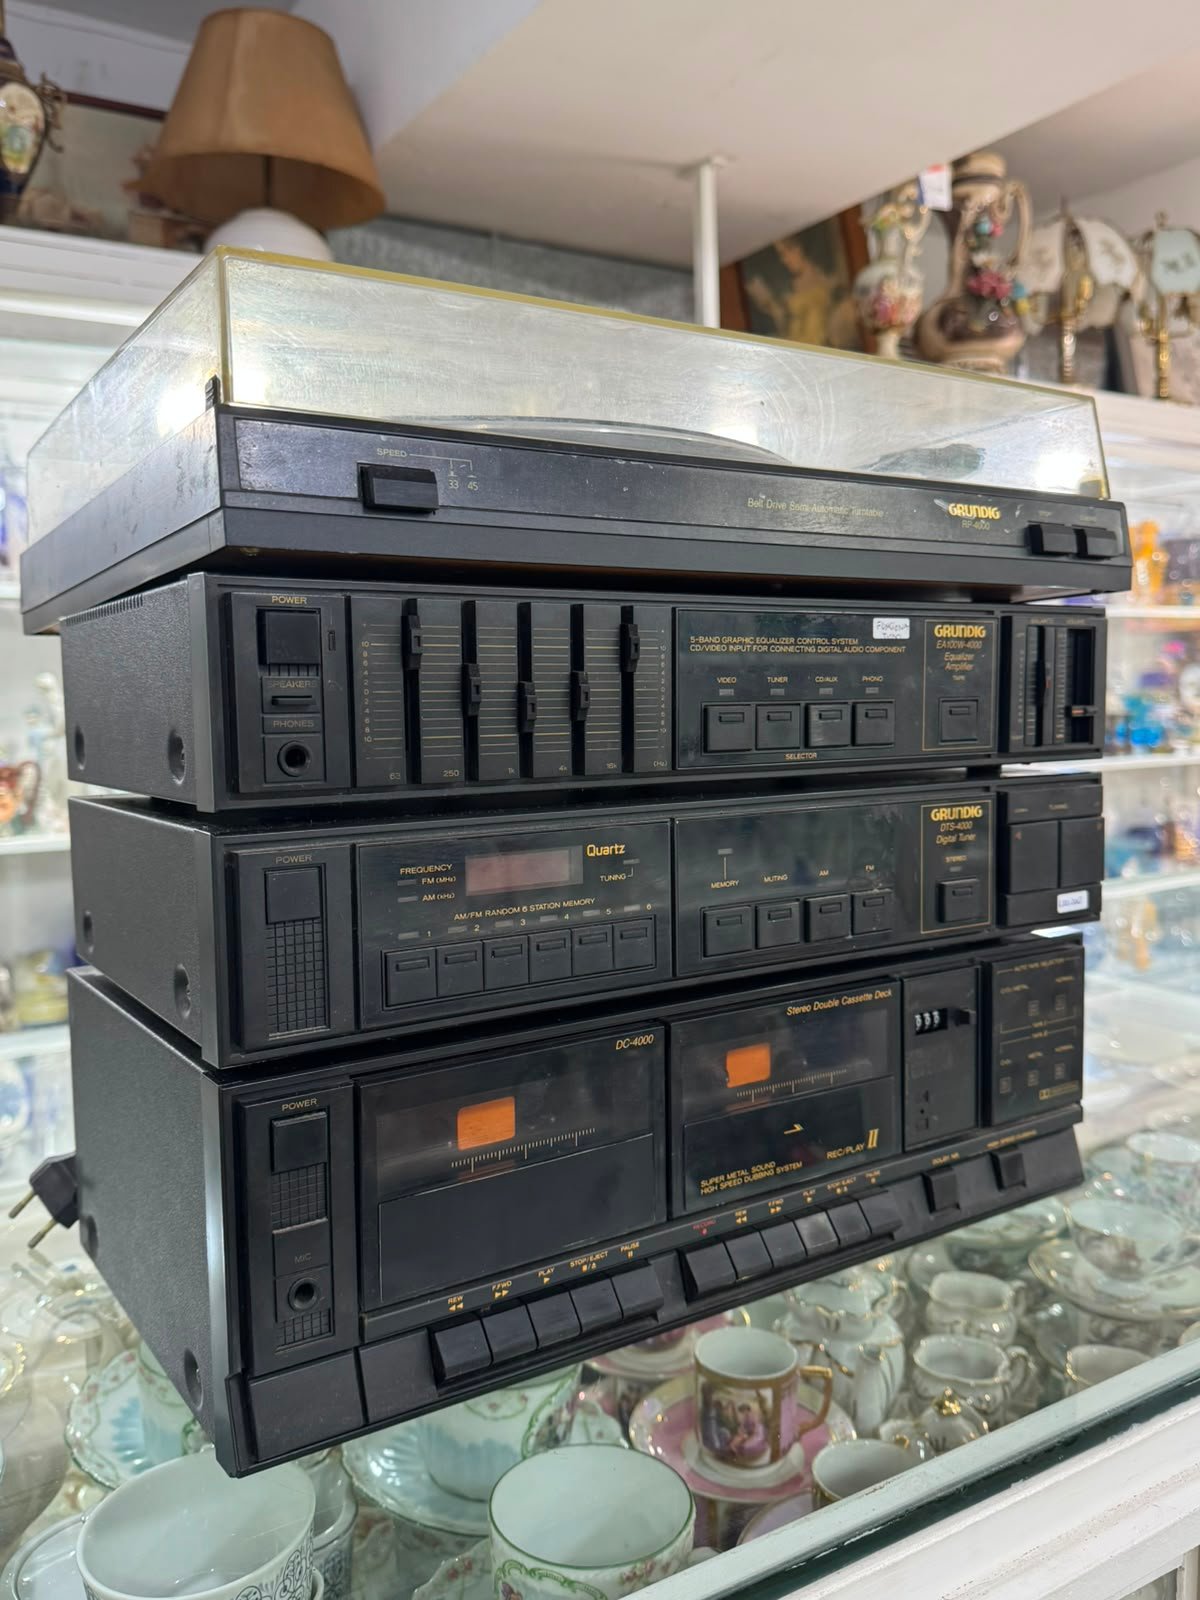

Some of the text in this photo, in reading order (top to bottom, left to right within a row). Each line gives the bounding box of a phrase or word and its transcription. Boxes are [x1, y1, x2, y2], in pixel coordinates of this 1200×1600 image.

[376, 447, 408, 458] SPEED
[449, 479, 479, 491] 33 45
[747, 497, 764, 508] Belt
[766, 499, 787, 511] Drive
[948, 502, 1001, 520] GRUNDIG
[271, 595, 308, 605] POWER
[934, 625, 986, 638] GRUNDIG
[690, 635, 859, 648] 5-BAND GRAPHIC EQUALIZER CONTROL SYSTEM
[689, 645, 906, 655] CD/VIDEO INPUT FOR CONNECTING DIGITAL AUDIO COMPONENT
[944, 652, 975, 662] Equalizer
[716, 676, 737, 684] VIDEO
[815, 675, 839, 683] CD/AUX
[862, 675, 884, 683] PHONO
[268, 680, 317, 689] SPEAKERS
[273, 720, 314, 729] PHONES
[785, 752, 817, 760] SELECTOR
[443, 769, 459, 778] 250
[558, 764, 568, 773] 4k
[389, 772, 400, 781] 63
[930, 805, 983, 821] GRUNDIG
[940, 821, 973, 832] DTS-4000
[936, 833, 976, 846] Digital Tuner
[586, 843, 626, 857] Quartz
[275, 854, 312, 864] POWER
[400, 863, 453, 875] FREQUENCY
[818, 869, 829, 877] AM
[421, 877, 434, 885] FM
[600, 873, 626, 882] TUNING
[763, 874, 789, 883] MUTING
[710, 879, 740, 889] MEMORY
[422, 894, 436, 902] AM
[453, 897, 596, 921] AM/FM RANDOM 6 STATION MEMORY
[520, 918, 526, 926] 3
[474, 924, 480, 932] 2
[786, 989, 893, 1017] Stereo Double Cassette Deck
[615, 1034, 654, 1050] DC-4000
[281, 1098, 318, 1112] POWER
[827, 1142, 865, 1159] REC/PLAY
[701, 1161, 776, 1188] SUPER METAL SOUND
[701, 1161, 803, 1195] HIGH SPEED DUBBING SYSTEM
[621, 1242, 640, 1253] PAUSE
[294, 1253, 312, 1263] MIC
[570, 1252, 609, 1268] STOP/EJECT
[538, 1268, 555, 1277] PLAY
[447, 1296, 464, 1305] REW
